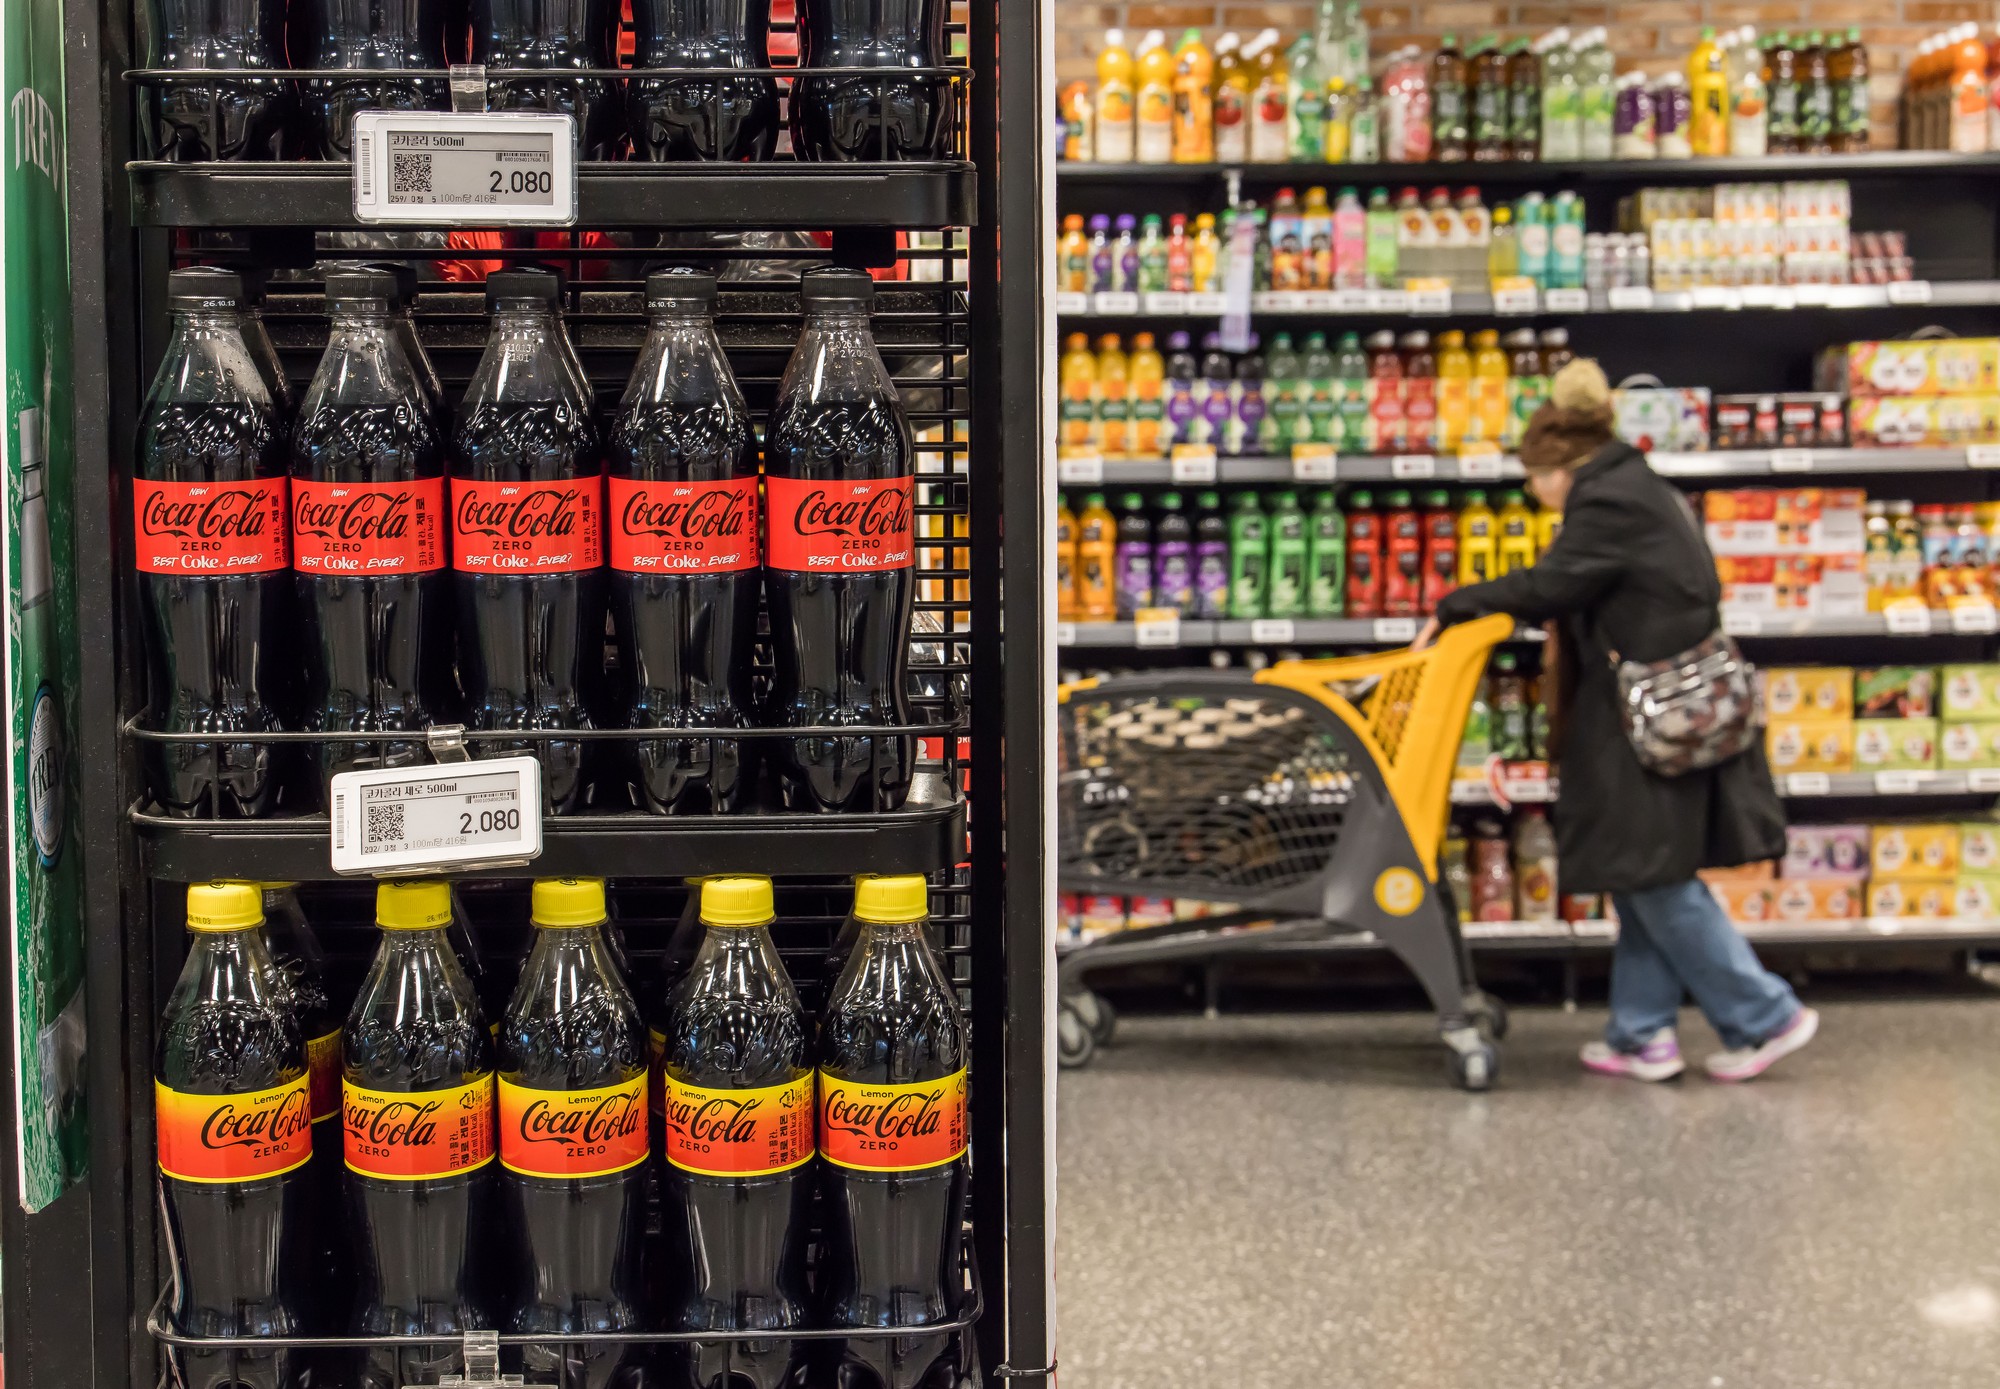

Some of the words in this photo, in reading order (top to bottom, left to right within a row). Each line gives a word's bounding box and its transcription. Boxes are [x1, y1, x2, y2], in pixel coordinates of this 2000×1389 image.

[391, 135, 429, 147] 코카콜라
[432, 136, 464, 147] 500ml
[489, 170, 551, 194] 2,080
[188, 487, 210, 497] NEW
[330, 488, 350, 498] NEW
[500, 486, 521, 496] NEW
[672, 487, 693, 497] NEW
[851, 486, 871, 495] NEW
[142, 489, 271, 539] Coca-Cola
[294, 491, 416, 539] Coca-Cola
[457, 489, 581, 538] Coca-Cola
[622, 489, 748, 538] Coca-Cola
[794, 486, 911, 537] Coca-Cola
[181, 542, 222, 551] ZERO
[324, 543, 362, 552] ZERO
[492, 541, 532, 550] ZERO
[664, 542, 704, 551] ZERO
[842, 539, 880, 549] ZERO
[153, 556, 179, 567] BEST
[226, 553, 263, 567] EVER?
[301, 556, 322, 568] BEST
[366, 555, 405, 569] EVER?
[465, 555, 491, 566] BEST
[536, 552, 573, 566] EVER?
[633, 556, 661, 567] BEST
[707, 552, 740, 566] EVER?
[807, 555, 840, 566] BEST
[366, 787, 401, 798] 코카콜라
[405, 785, 423, 796] 제로
[427, 782, 457, 794] 500ml
[459, 808, 519, 834] 2,080
[254, 1092, 285, 1105] Lemon
[358, 1093, 385, 1105] Lemon
[568, 1095, 602, 1104] Lemon
[680, 1088, 706, 1100] Lemon
[860, 1089, 894, 1098] Lemon
[520, 1086, 644, 1145] Coca-Cola
[825, 1087, 947, 1138] Coca-Cola
[254, 1142, 289, 1158] ZERO
[358, 1143, 390, 1158] ZERO
[566, 1145, 606, 1157] ZERO
[679, 1138, 710, 1153] ZERO
[859, 1140, 898, 1151] ZERO
